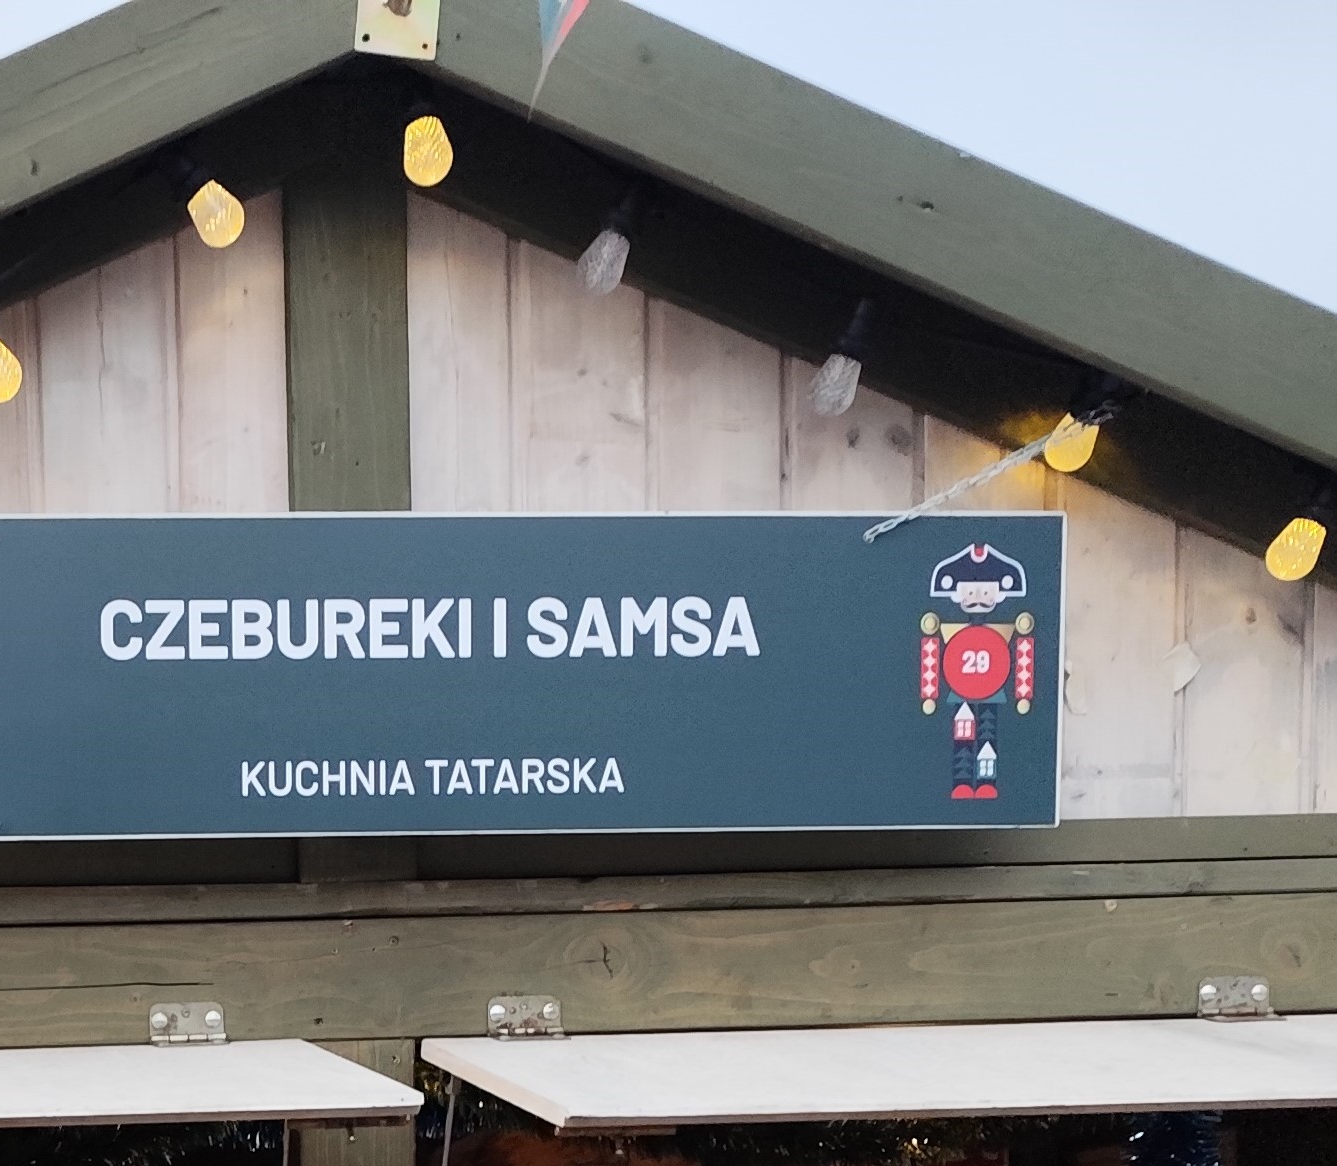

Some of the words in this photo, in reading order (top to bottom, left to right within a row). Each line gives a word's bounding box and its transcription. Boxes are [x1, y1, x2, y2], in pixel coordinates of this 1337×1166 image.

[100, 598, 472, 660] CZEBUREKI
[493, 597, 507, 658] I
[527, 596, 761, 658] SAMSA
[961, 650, 990, 674] 29
[241, 759, 415, 797] KUCHNIA
[425, 757, 625, 795] TATARSKA
